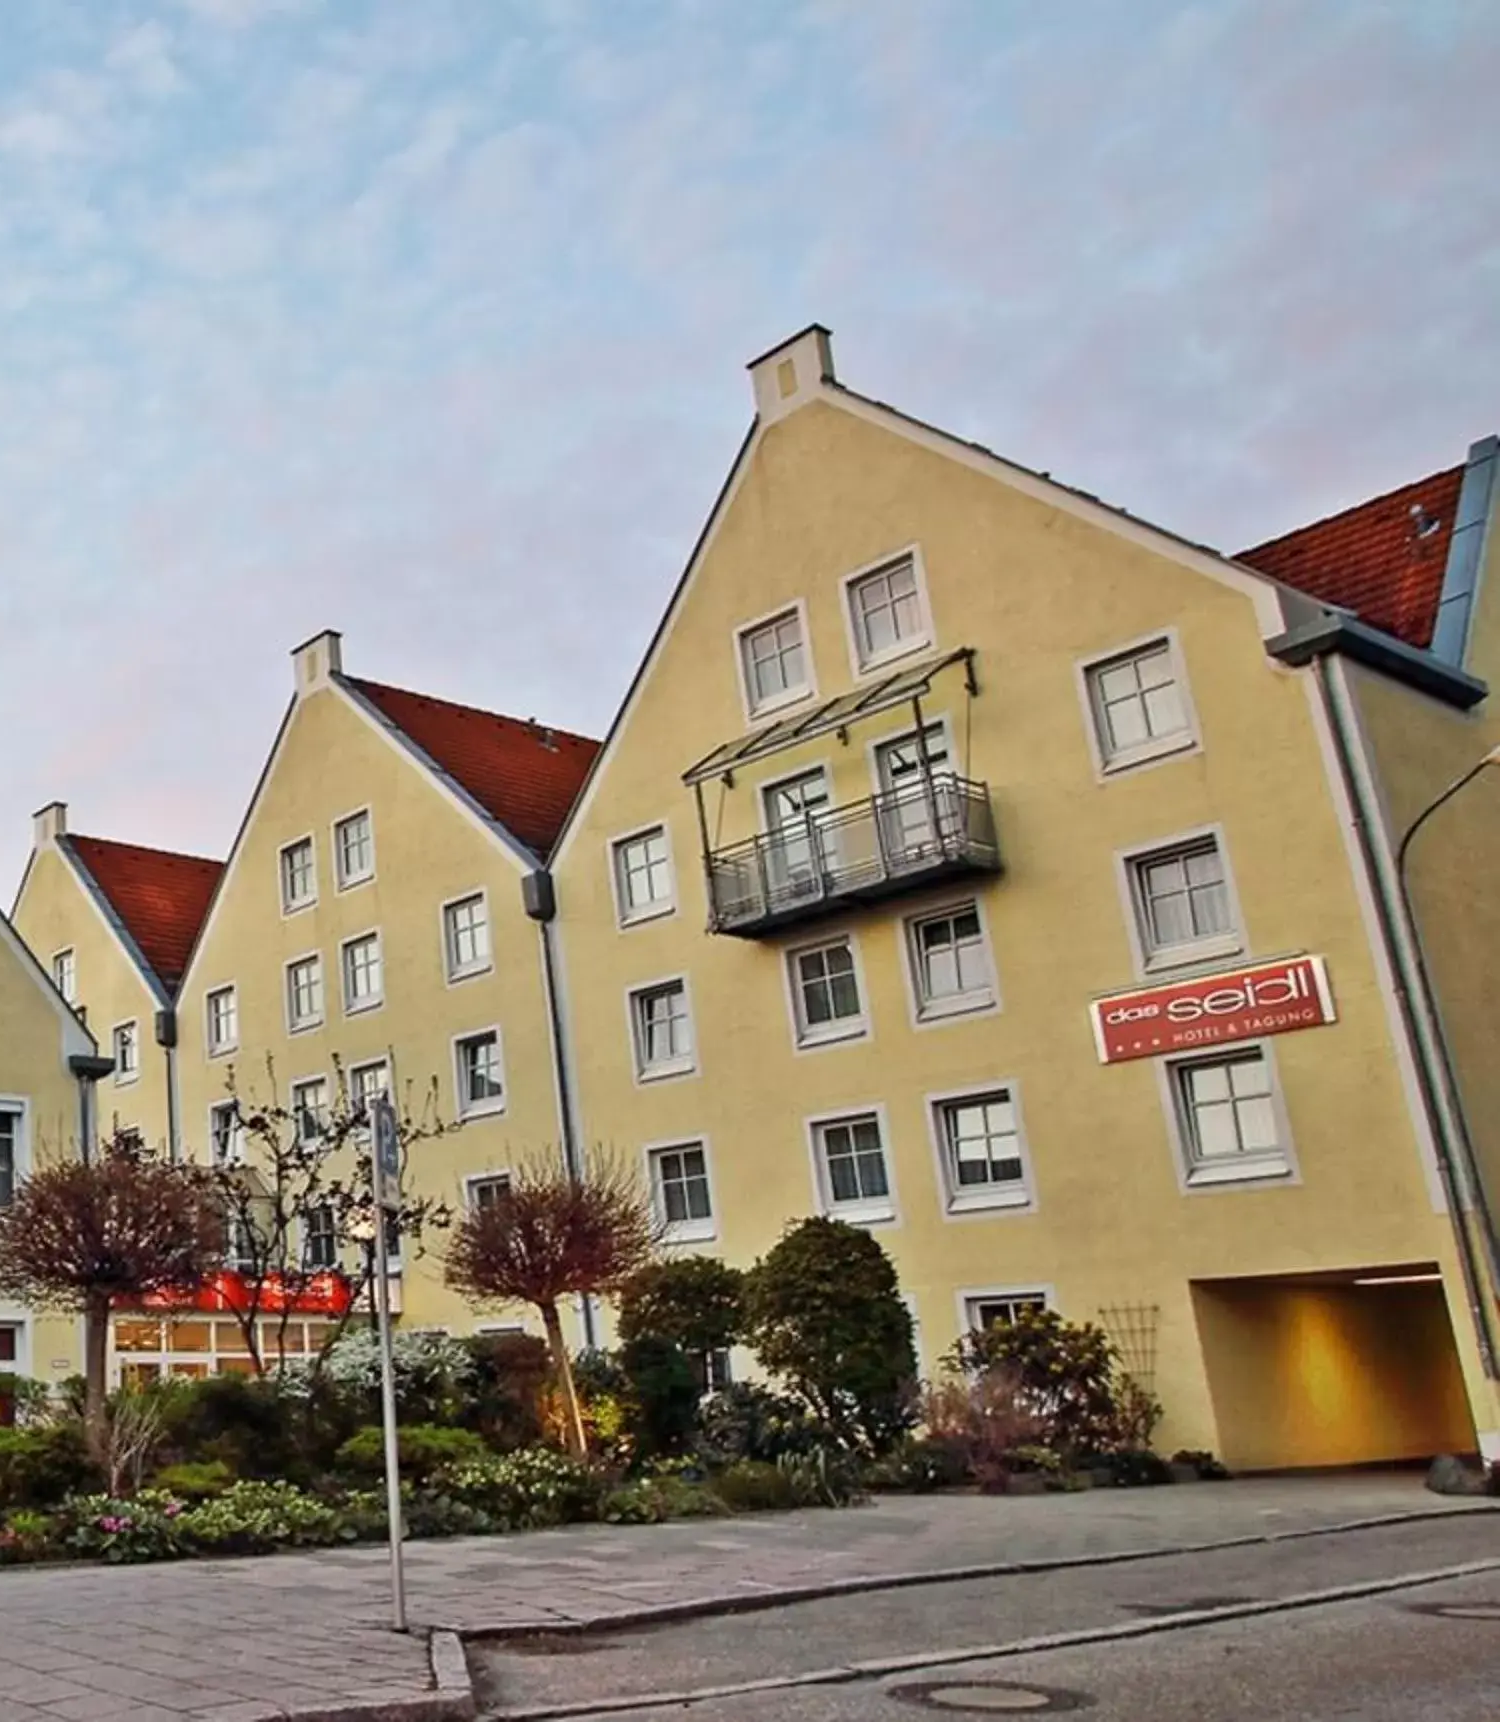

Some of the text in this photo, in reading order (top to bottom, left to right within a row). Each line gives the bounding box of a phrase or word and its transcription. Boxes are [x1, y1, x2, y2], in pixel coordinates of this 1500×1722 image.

[1106, 966, 1309, 1024] das seidl
[1173, 1028, 1220, 1043] HOTEL
[1244, 1009, 1315, 1030] TAGUNG
